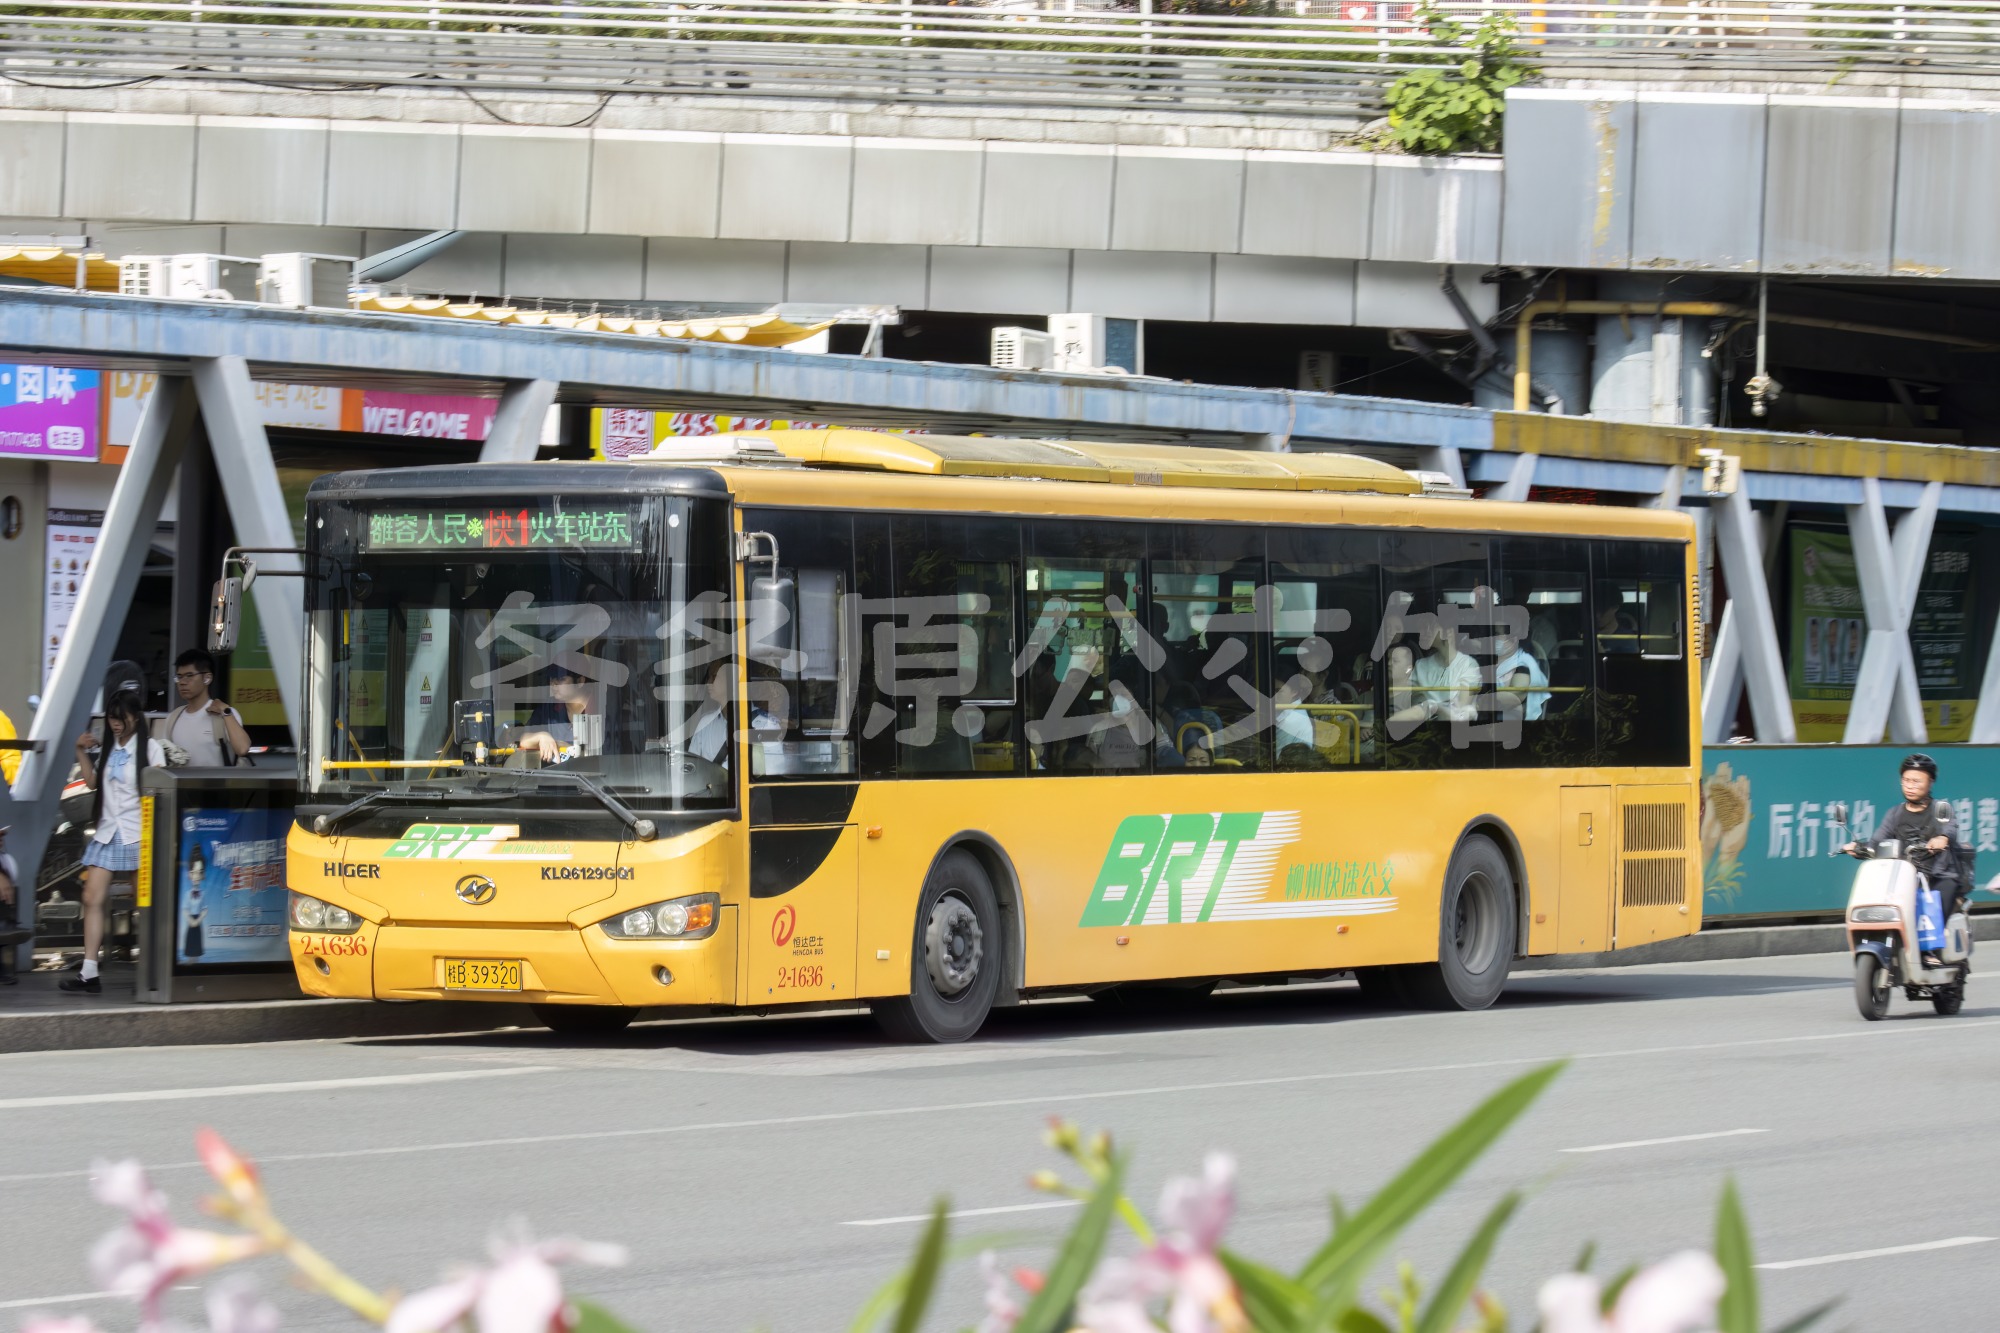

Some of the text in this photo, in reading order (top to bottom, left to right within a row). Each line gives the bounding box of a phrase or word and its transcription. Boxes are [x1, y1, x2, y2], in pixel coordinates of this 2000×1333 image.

[363, 406, 470, 439] WELCOME
[484, 509, 528, 547] 快1
[531, 512, 631, 545] 火车站东
[382, 825, 494, 858] BRT
[1767, 799, 1876, 859] 厉行节约
[324, 861, 380, 879] HIGER
[541, 865, 635, 881] KLQ6129GQ1
[1078, 811, 1265, 928] BRT
[1285, 859, 1396, 901] 柳州快速公交
[301, 935, 368, 957] 2-1636
[793, 936, 824, 948] 恒达巴士
[778, 965, 823, 988] 2-1636
